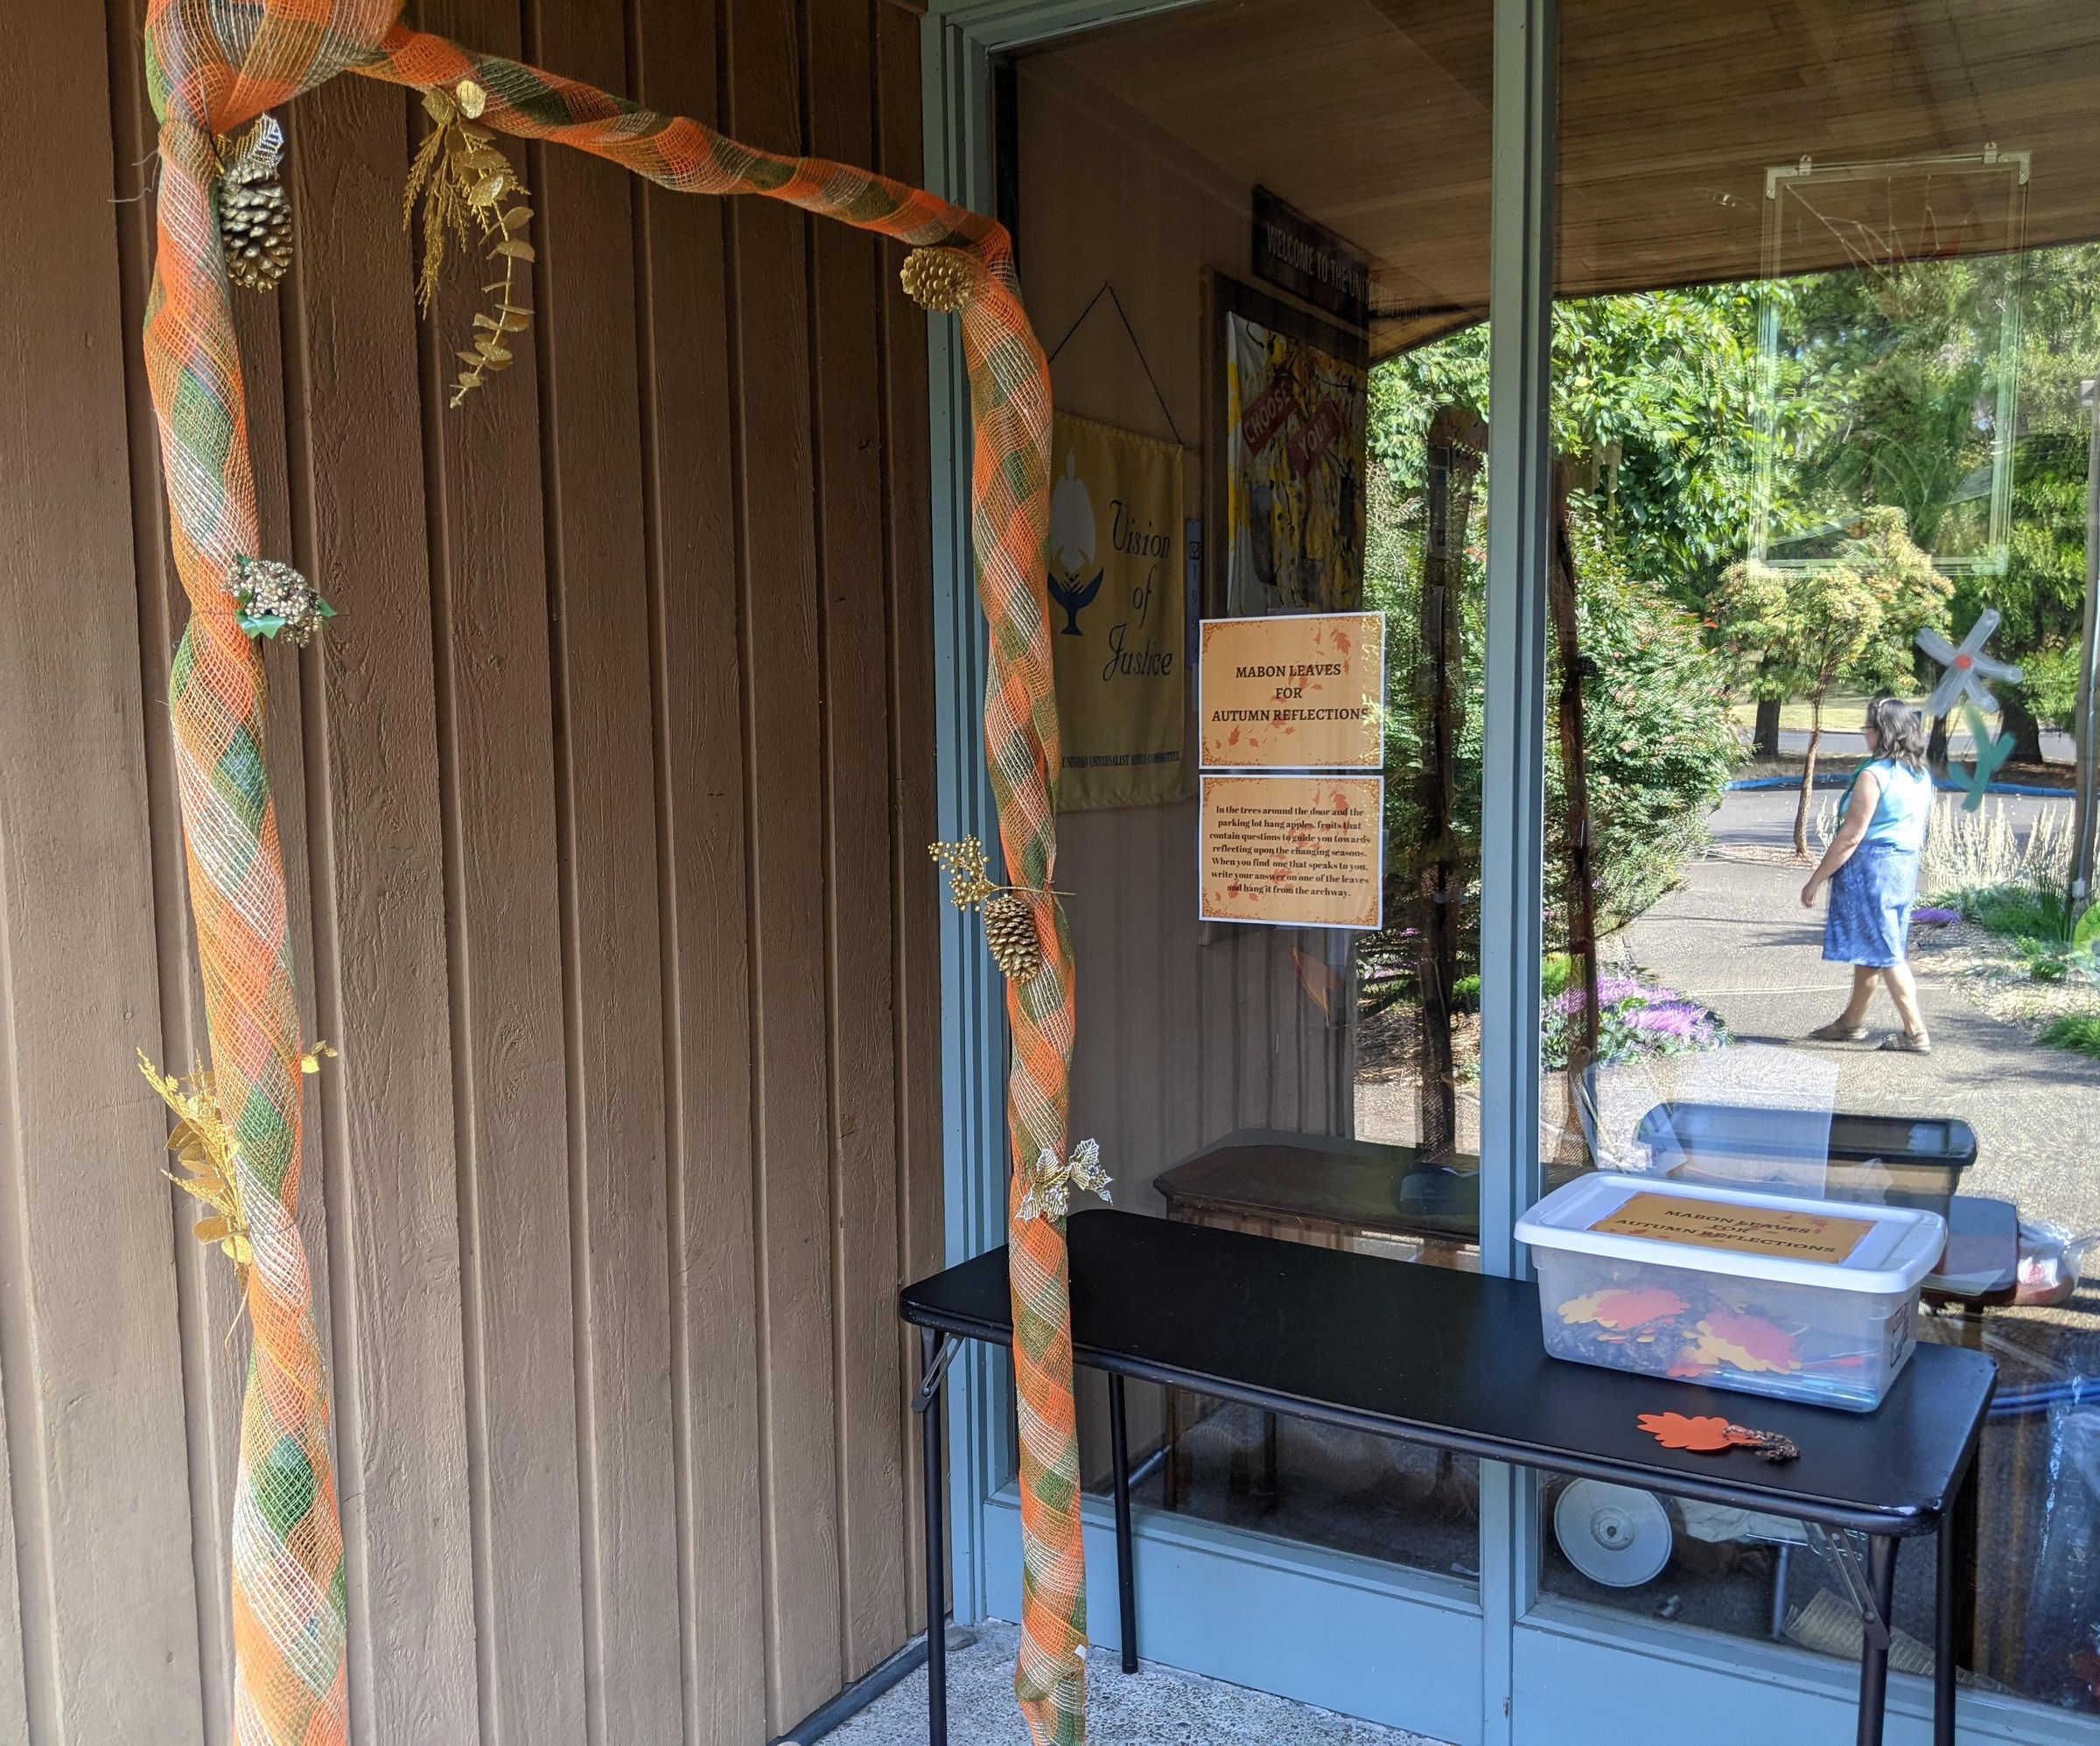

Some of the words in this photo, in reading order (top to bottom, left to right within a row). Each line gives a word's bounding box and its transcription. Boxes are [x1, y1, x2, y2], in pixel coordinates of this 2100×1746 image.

[1267, 222, 1314, 276] WELCOME
[1316, 251, 1328, 284] TO
[1331, 259, 1348, 294] THE
[1243, 381, 1292, 444] CHOOSE
[1298, 413, 1331, 460] YOUR
[1110, 500, 1171, 558] Vision
[1132, 564, 1158, 630] of
[1102, 623, 1172, 682] Justice
[1236, 665, 1285, 678] MABON
[1289, 663, 1341, 677] LEAVES
[1276, 687, 1302, 698] FOR
[1212, 710, 1270, 722] AUTUMN
[1273, 708, 1368, 721] REFLECTIONS
[1218, 819, 1250, 829] parking
[1264, 819, 1285, 830] hang
[1317, 820, 1341, 829] fruits
[1343, 821, 1362, 830] that
[1242, 833, 1281, 842] questions
[1292, 834, 1315, 843] guide
[1213, 845, 1252, 855] reflecting
[1292, 847, 1330, 858] changing
[1212, 857, 1236, 866] When
[1308, 861, 1338, 871] speaks
[1243, 884, 1264, 894] hang
[1311, 887, 1351, 899] archway.
[1663, 1210, 1734, 1224] MABON
[1738, 1220, 1813, 1234] LEAVES
[1712, 1224, 1752, 1233] FOR
[1616, 1218, 1698, 1234] AUTUMN
[1701, 1230, 1837, 1253] REFLECTIONS
